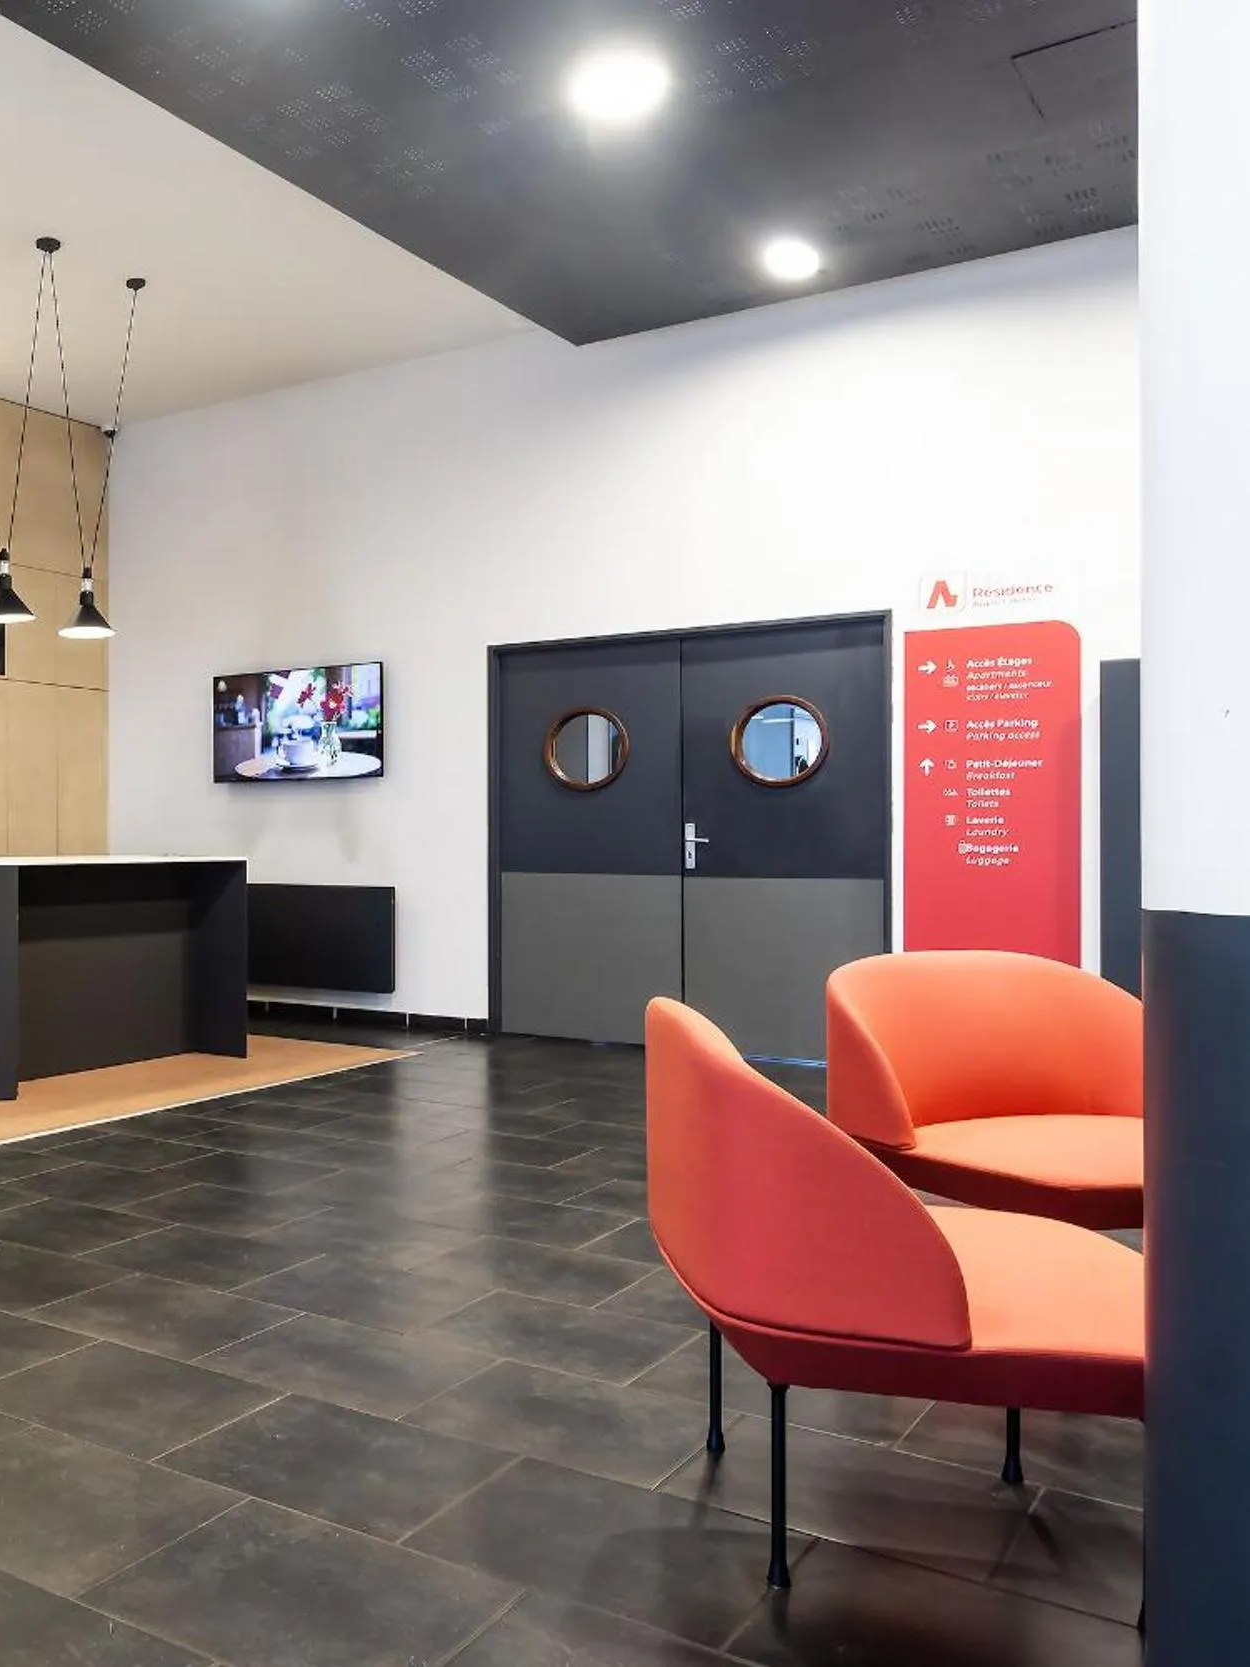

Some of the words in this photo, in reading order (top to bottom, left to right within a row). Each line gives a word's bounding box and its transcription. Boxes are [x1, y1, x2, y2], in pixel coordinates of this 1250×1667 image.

[997, 718, 1038, 728] Parking
[966, 731, 1005, 740] Parking
[1008, 731, 1040, 739] access
[966, 771, 1015, 780] Breakfast
[966, 787, 1010, 797] Toilettes
[966, 799, 999, 808] Toilets
[966, 815, 1004, 825] Laverie
[966, 827, 1009, 837] Laundry
[966, 843, 1019, 854] Bagagerie
[966, 856, 1009, 866] Luggage
